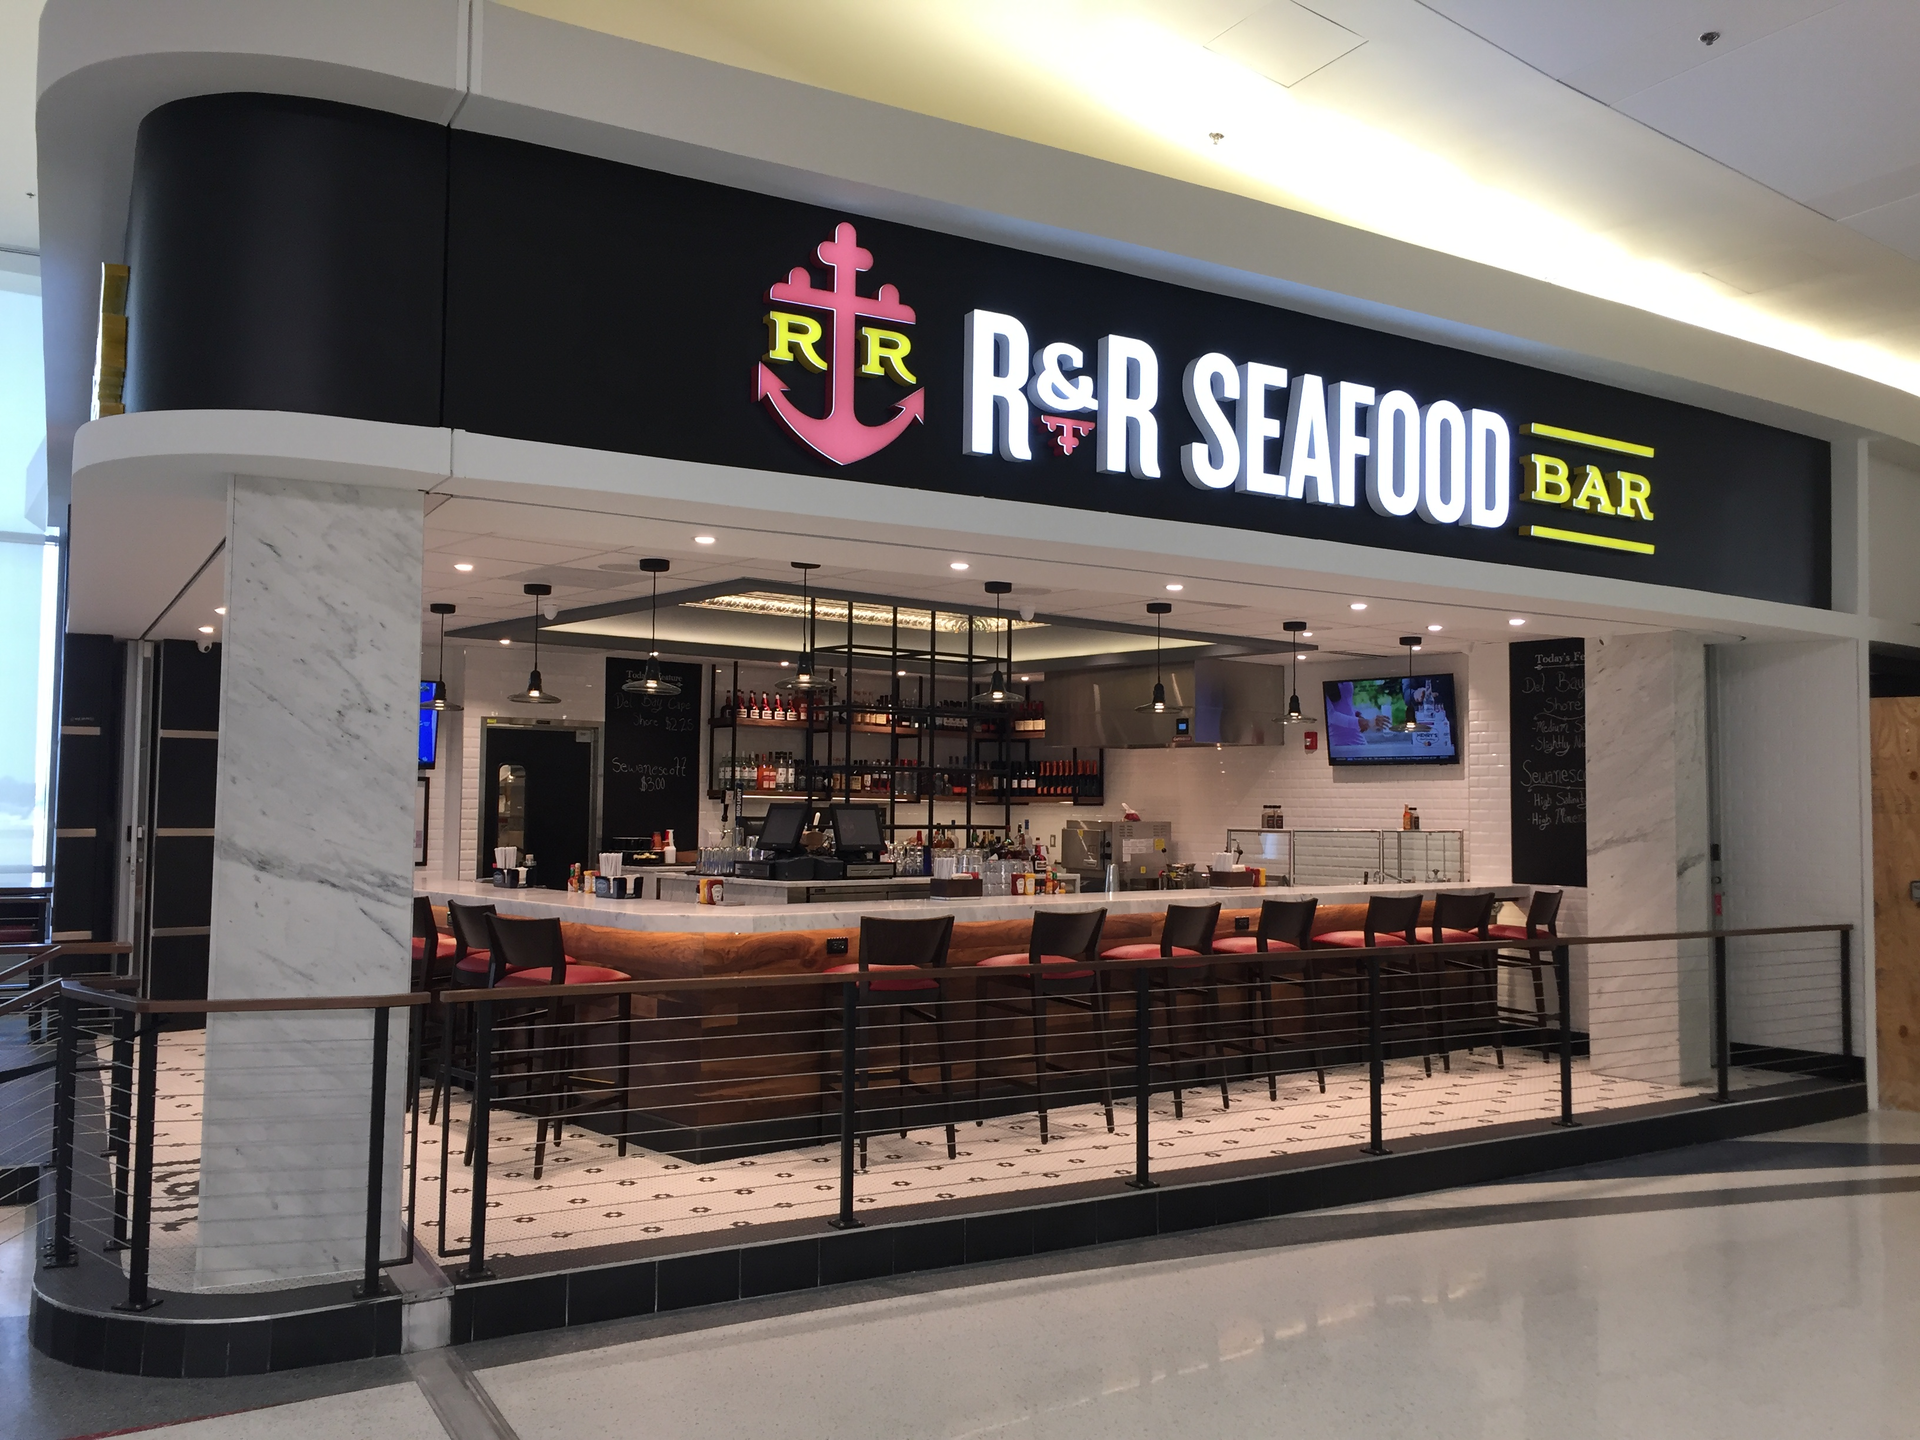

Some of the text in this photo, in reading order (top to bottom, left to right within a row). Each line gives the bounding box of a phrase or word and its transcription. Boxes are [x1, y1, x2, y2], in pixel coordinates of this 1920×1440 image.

[765, 310, 917, 385] R R
[964, 309, 1655, 529] R&R SEAFOOD BAR
[1534, 652, 1570, 664] Today's
[1521, 671, 1585, 698] Del Bay
[613, 692, 632, 709] Del
[1543, 696, 1583, 713] Shore
